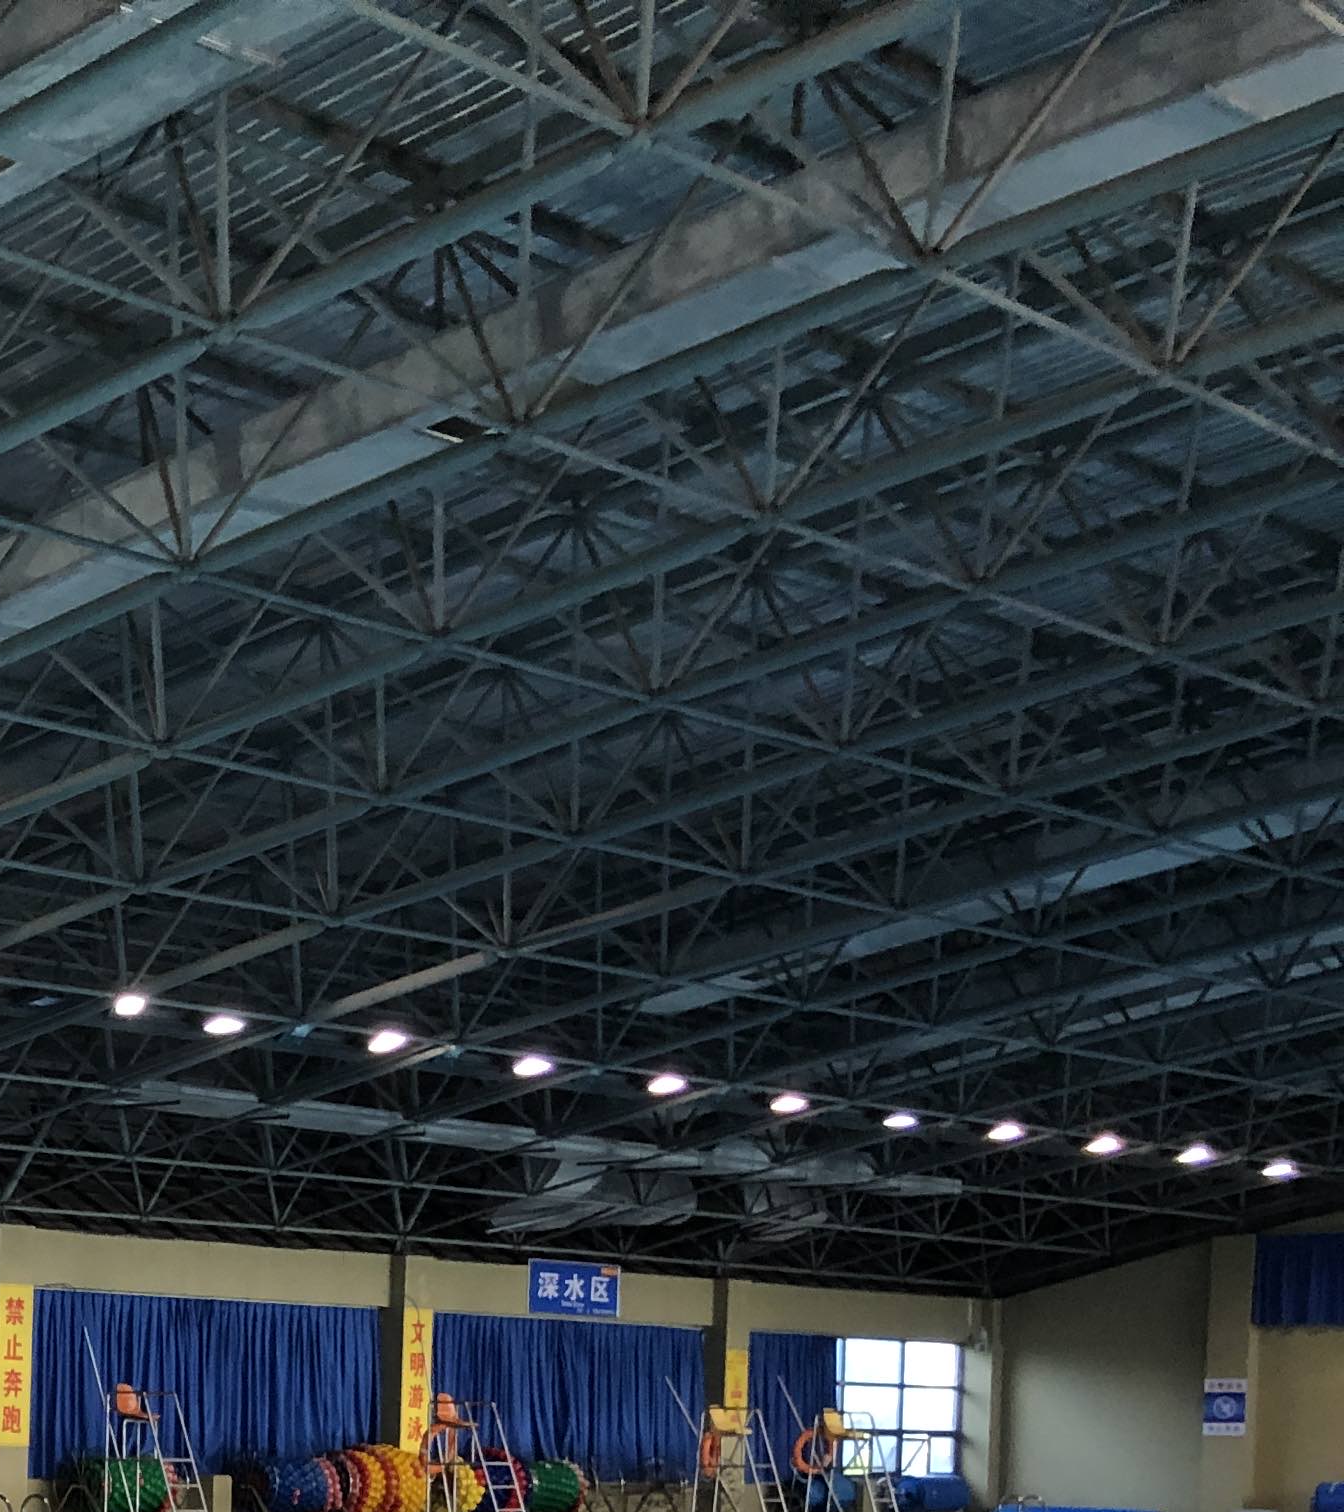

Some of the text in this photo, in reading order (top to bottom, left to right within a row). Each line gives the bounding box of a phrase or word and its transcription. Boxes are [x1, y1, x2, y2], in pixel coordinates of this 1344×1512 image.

[537, 1271, 610, 1303] 深水区
[1, 1296, 25, 1434] 禁止奔跑
[407, 1321, 425, 1442] 文明游泳
